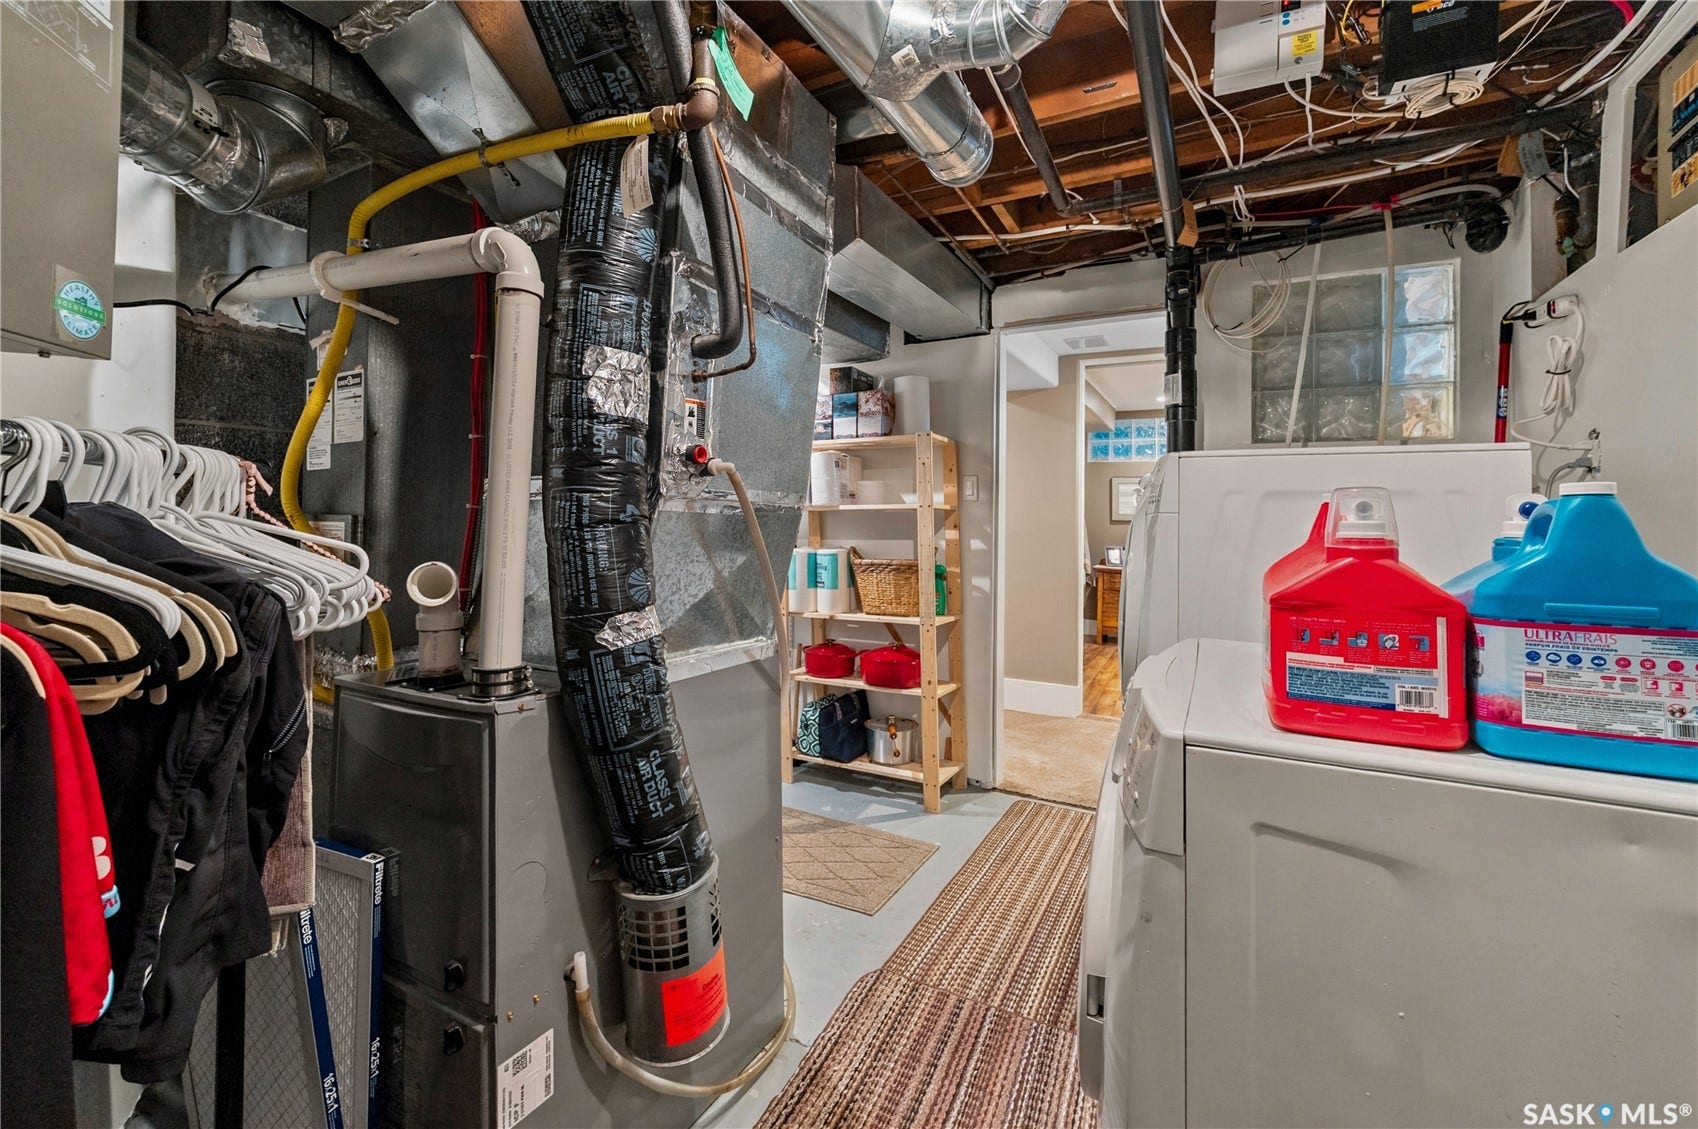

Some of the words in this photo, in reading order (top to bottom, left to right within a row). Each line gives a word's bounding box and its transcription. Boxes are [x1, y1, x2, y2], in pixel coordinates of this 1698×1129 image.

[602, 72, 624, 101] AIR
[598, 218, 606, 230] USE
[596, 230, 605, 247] ONLY
[64, 284, 99, 306] HEALTHY
[63, 314, 98, 336] CLIMATE
[606, 447, 618, 455] 1
[586, 554, 596, 578] INDOOR
[589, 579, 597, 591] USE
[591, 592, 599, 609] ONLY
[1524, 629, 1617, 644] ULTRAFRAIS
[636, 757, 653, 781] AIR
[649, 749, 671, 799] CLASS
[663, 803, 675, 812] 1
[644, 780, 663, 819] DUCT
[374, 862, 384, 905] Filtrete
[370, 1037, 380, 1078] 16x25x1
[323, 1072, 339, 1114] 16x25x1
